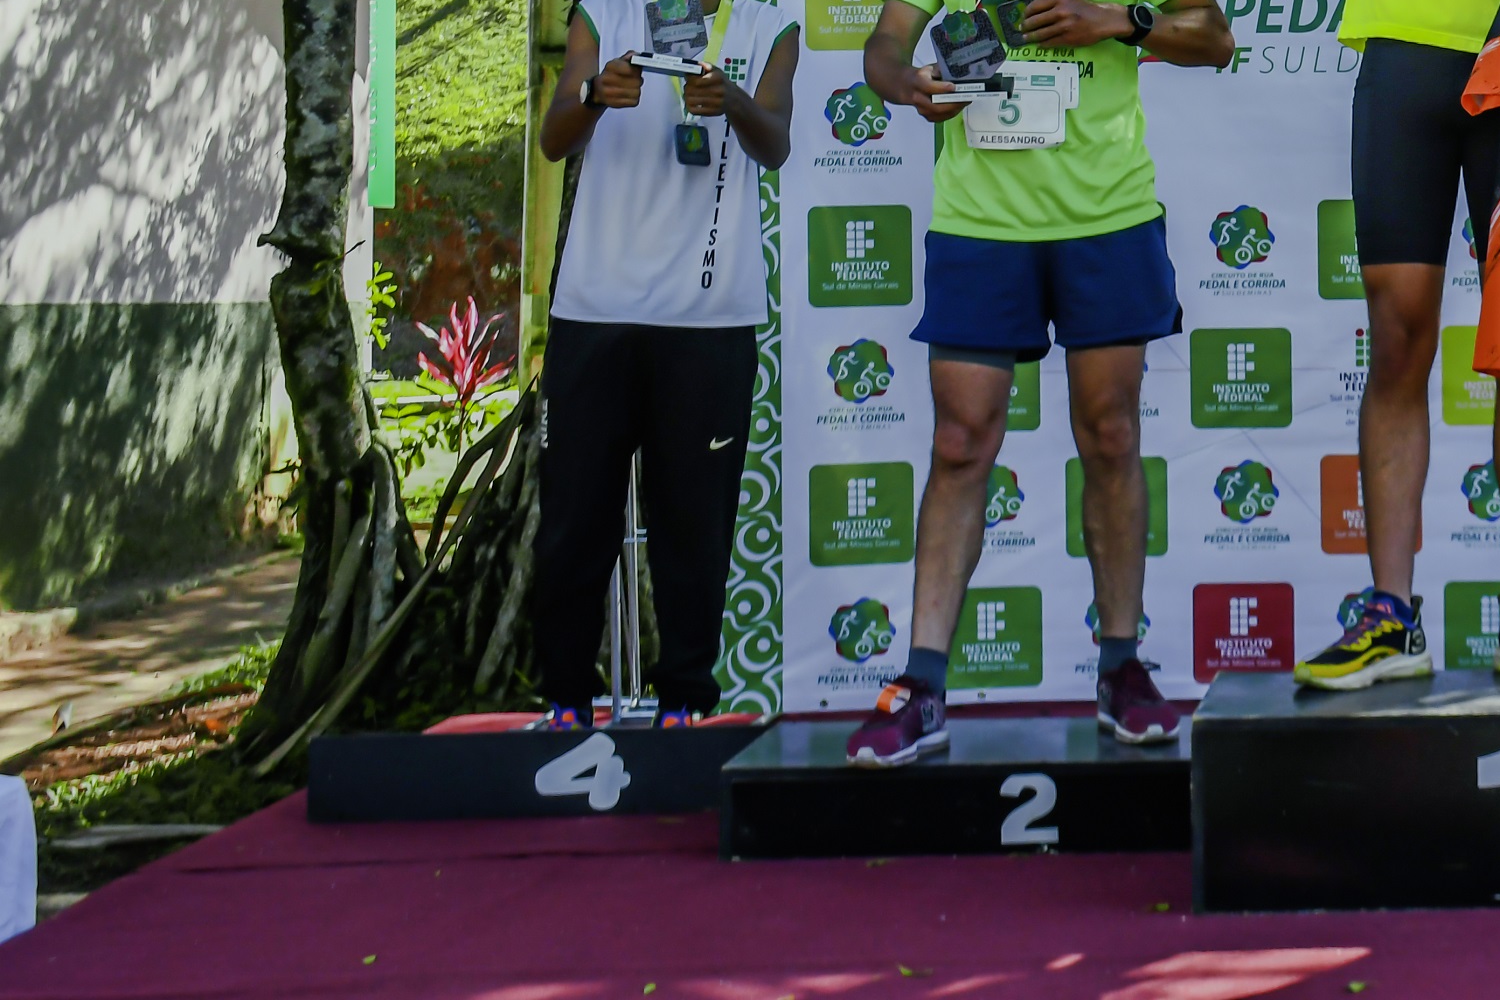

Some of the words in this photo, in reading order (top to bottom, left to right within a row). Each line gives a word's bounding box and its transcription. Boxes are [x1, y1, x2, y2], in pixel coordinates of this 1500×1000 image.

[1035, 48, 1048, 57] DE
[1053, 48, 1074, 57] RUA
[998, 94, 1022, 126] 5
[980, 135, 1045, 144] ALESSANDRO
[814, 157, 846, 166] PEDAL
[849, 157, 855, 166] E
[858, 156, 902, 166] CORRIDA
[701, 119, 731, 289] TLETISMO
[831, 261, 889, 271] INSTITUTO
[837, 270, 884, 280] FEDERAL
[1200, 280, 1231, 289] PEDAL
[1234, 280, 1240, 288] E
[1242, 279, 1286, 288] CORRIDA
[1213, 384, 1269, 393] INSTITUTO
[1218, 392, 1264, 402] FEDERAL
[817, 415, 849, 425] PEDAL
[852, 415, 858, 424] E
[860, 413, 905, 423] CORRIDA
[833, 518, 891, 529] INSTITUTO
[838, 527, 885, 538] FEDERAL
[962, 642, 1020, 653] INSTITUTO
[1216, 638, 1272, 647] INSTITUTO
[968, 651, 1014, 662] FEDERAL
[1221, 647, 1267, 656] FEDERAL
[536, 732, 630, 810] 4
[1000, 773, 1059, 845] 2
